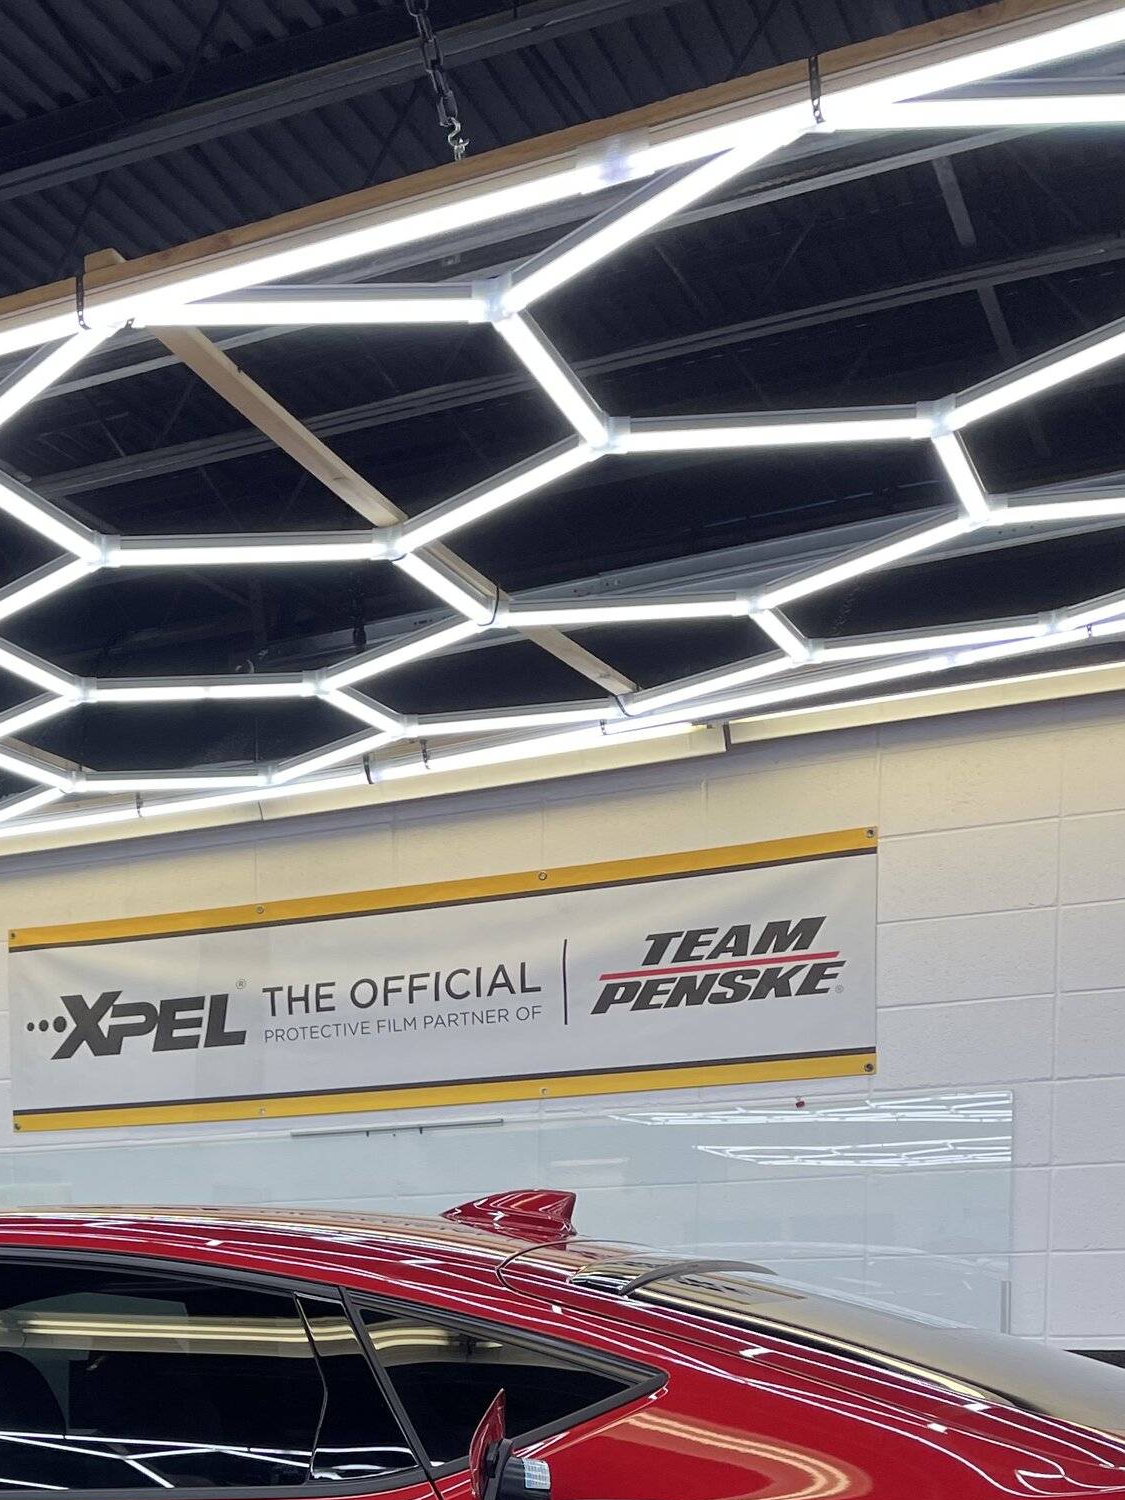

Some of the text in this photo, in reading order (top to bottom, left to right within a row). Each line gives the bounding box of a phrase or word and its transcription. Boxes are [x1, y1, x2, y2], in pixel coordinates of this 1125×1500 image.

[641, 916, 827, 966] TEAM
[262, 961, 542, 1017] THE OFFICIAL
[590, 960, 847, 1015] PENSKE
[50, 990, 247, 1060] XPEL
[264, 1005, 543, 1043] PROTECTIVE FILM PARTNER OF
